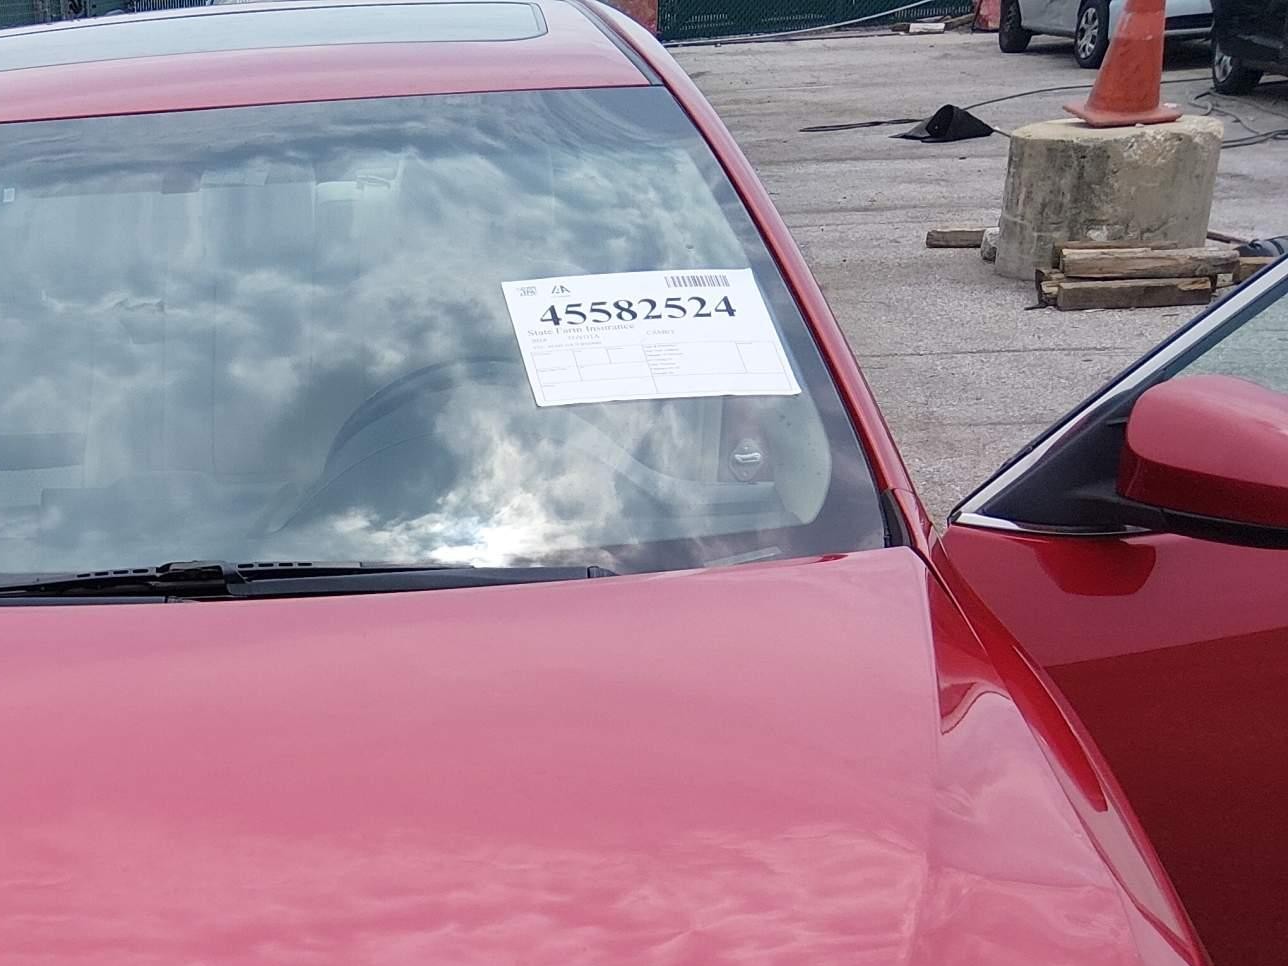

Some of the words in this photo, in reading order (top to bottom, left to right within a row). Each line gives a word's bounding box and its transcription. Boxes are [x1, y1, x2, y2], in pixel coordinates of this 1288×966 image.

[539, 295, 737, 327] 45582524
[527, 328, 553, 337] State
[555, 326, 583, 335] Farm
[586, 323, 635, 333] Insurance
